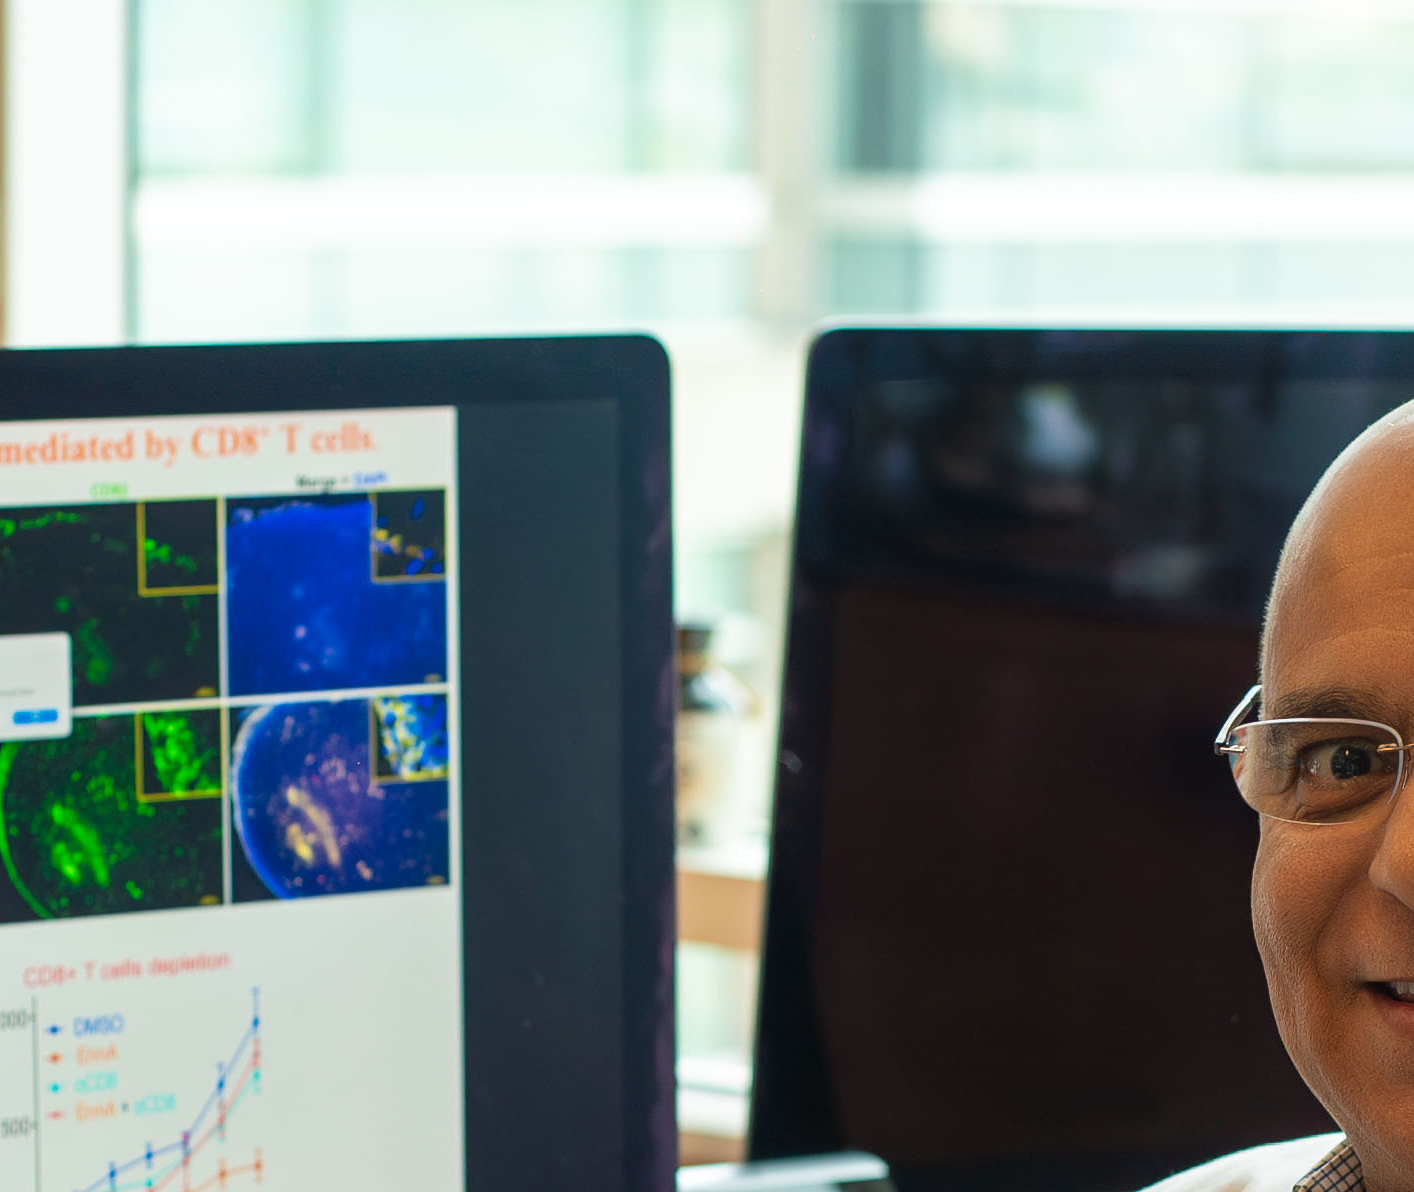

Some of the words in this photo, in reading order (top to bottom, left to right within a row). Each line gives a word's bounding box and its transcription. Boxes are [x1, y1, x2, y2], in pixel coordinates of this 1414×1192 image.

[145, 428, 179, 468] by
[279, 421, 302, 455] T
[310, 420, 380, 455] cells.
[73, 1014, 124, 1037] DMSO
